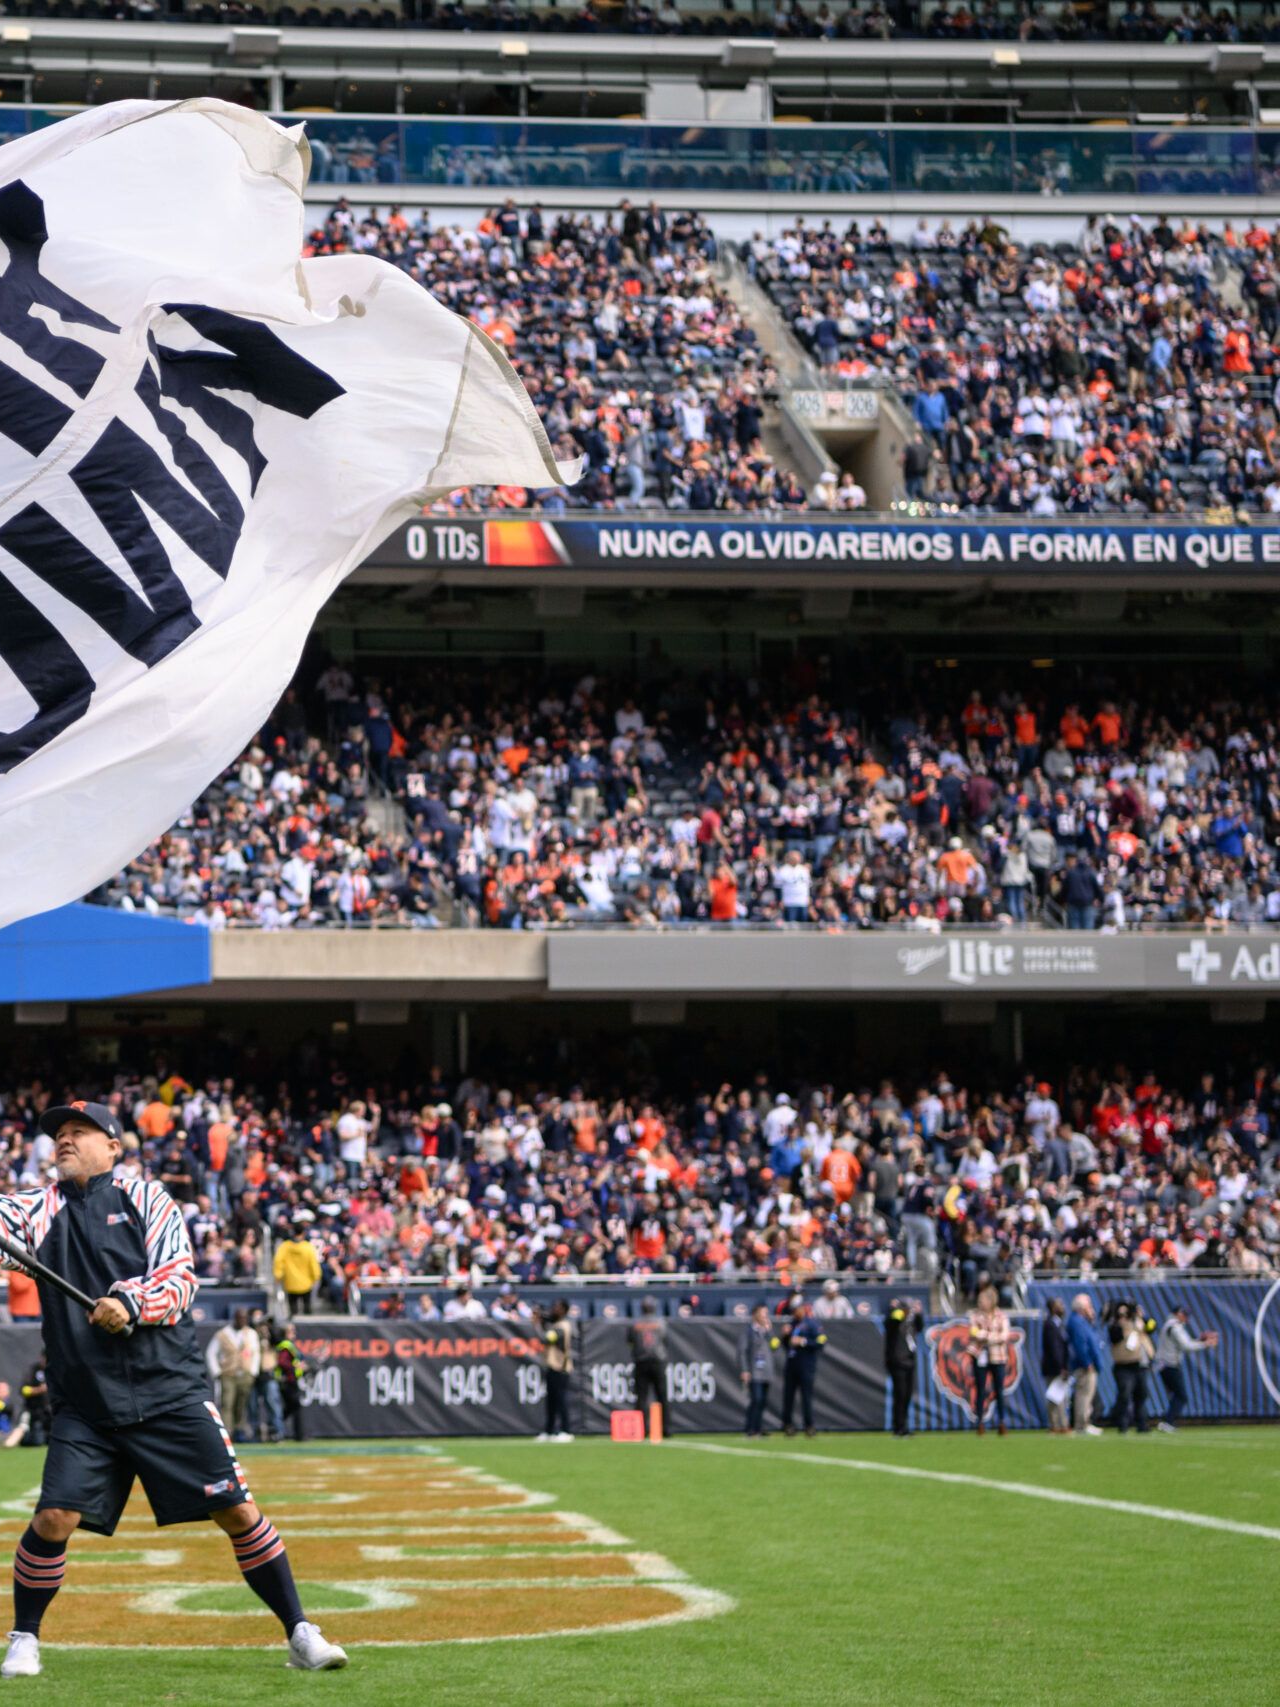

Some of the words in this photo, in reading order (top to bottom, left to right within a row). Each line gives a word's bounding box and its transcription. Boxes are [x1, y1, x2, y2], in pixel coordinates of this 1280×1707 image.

[407, 525, 427, 560] 0
[433, 525, 480, 561] TDs
[598, 529, 714, 559] NUNCA
[720, 530, 953, 561] OLVIDAREMOS
[960, 532, 1005, 561] LA
[1010, 532, 1126, 562] FORMA
[1132, 533, 1178, 562] EN
[1184, 533, 1253, 568] QUE
[947, 939, 1016, 985] Lite
[366, 1365, 415, 1406] 1941
[439, 1364, 493, 1406] 1943
[665, 1362, 717, 1403] 1985
